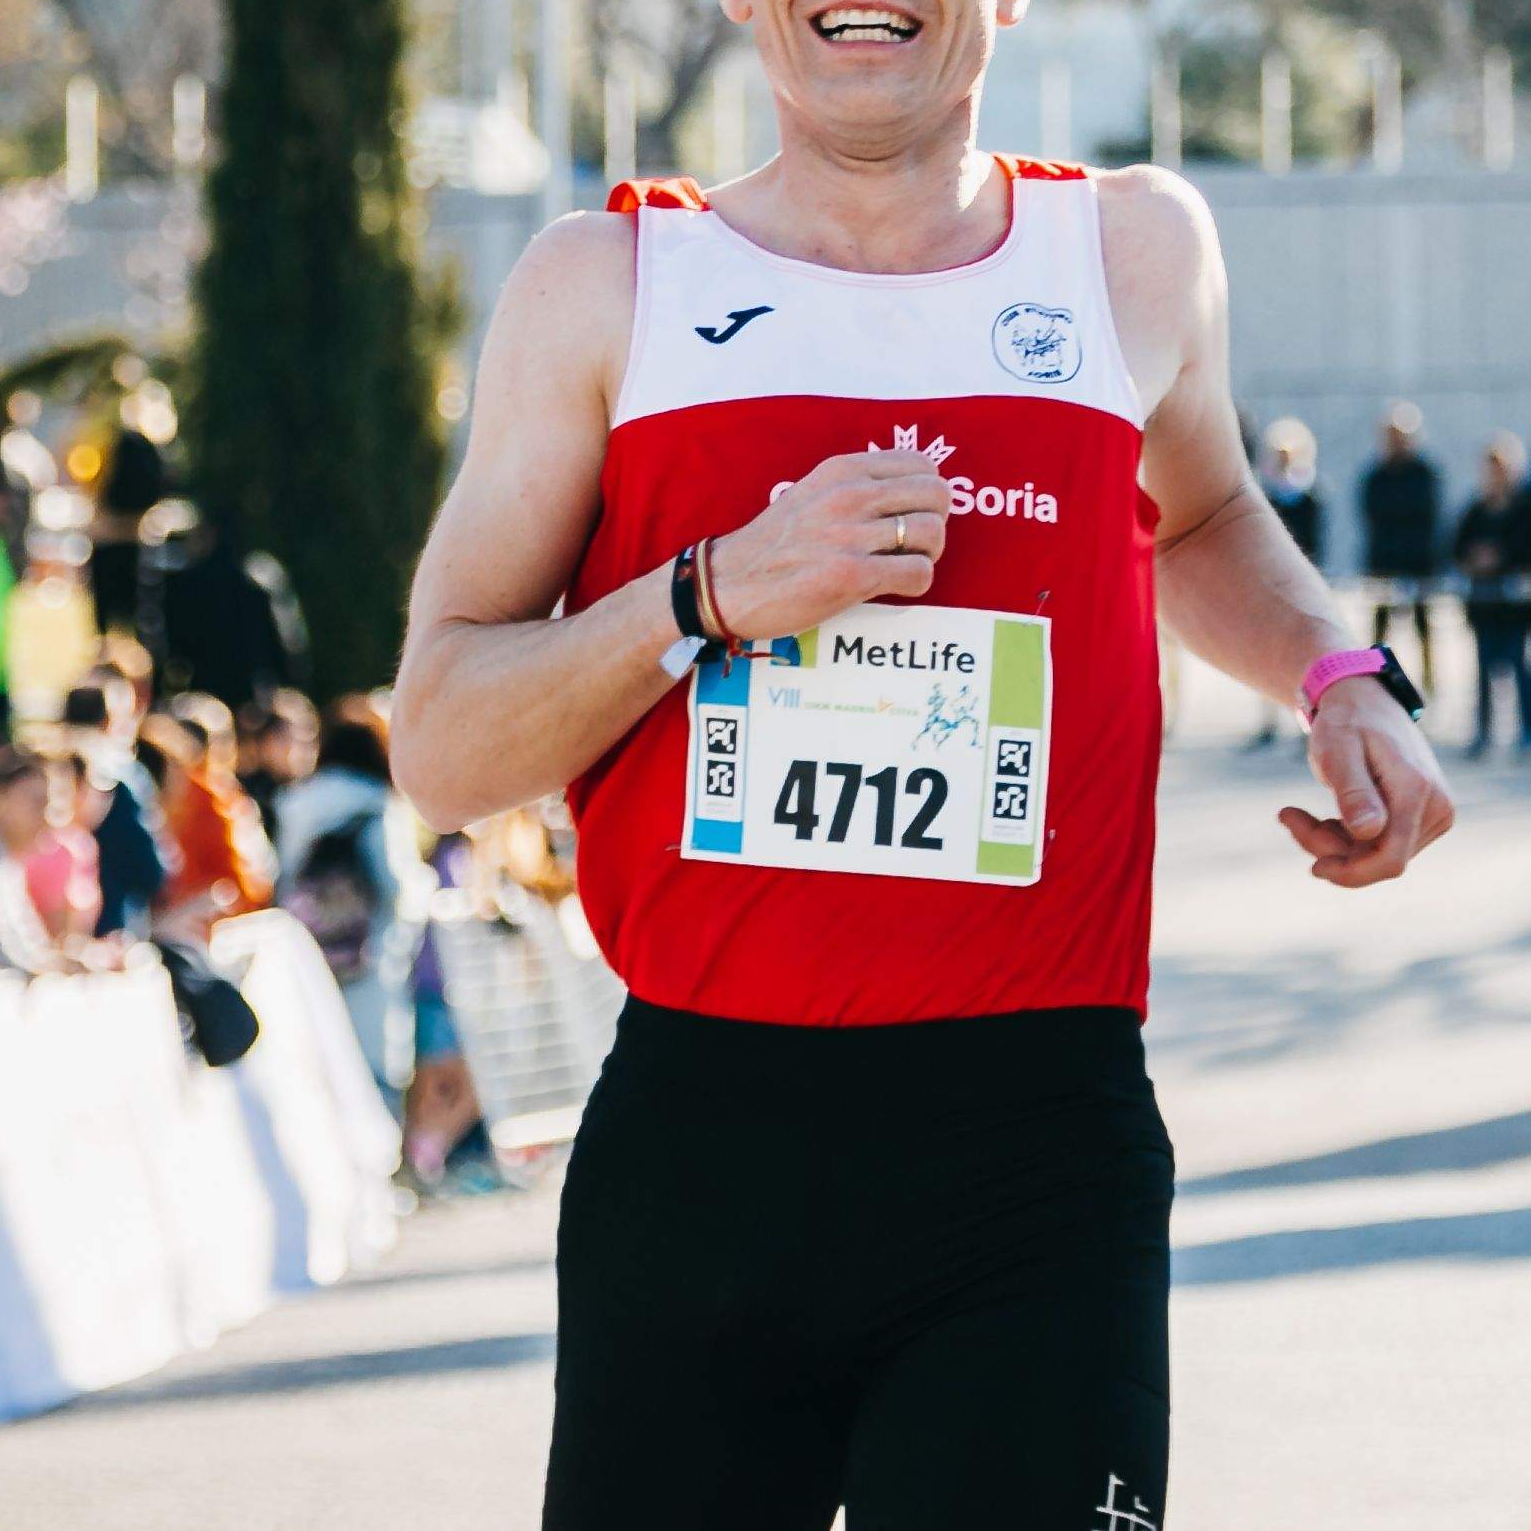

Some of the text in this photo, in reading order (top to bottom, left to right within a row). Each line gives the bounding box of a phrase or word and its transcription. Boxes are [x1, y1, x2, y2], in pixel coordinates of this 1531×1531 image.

[947, 475, 1059, 524] Soria
[832, 634, 976, 674] MetLife
[774, 760, 949, 851] 4712
